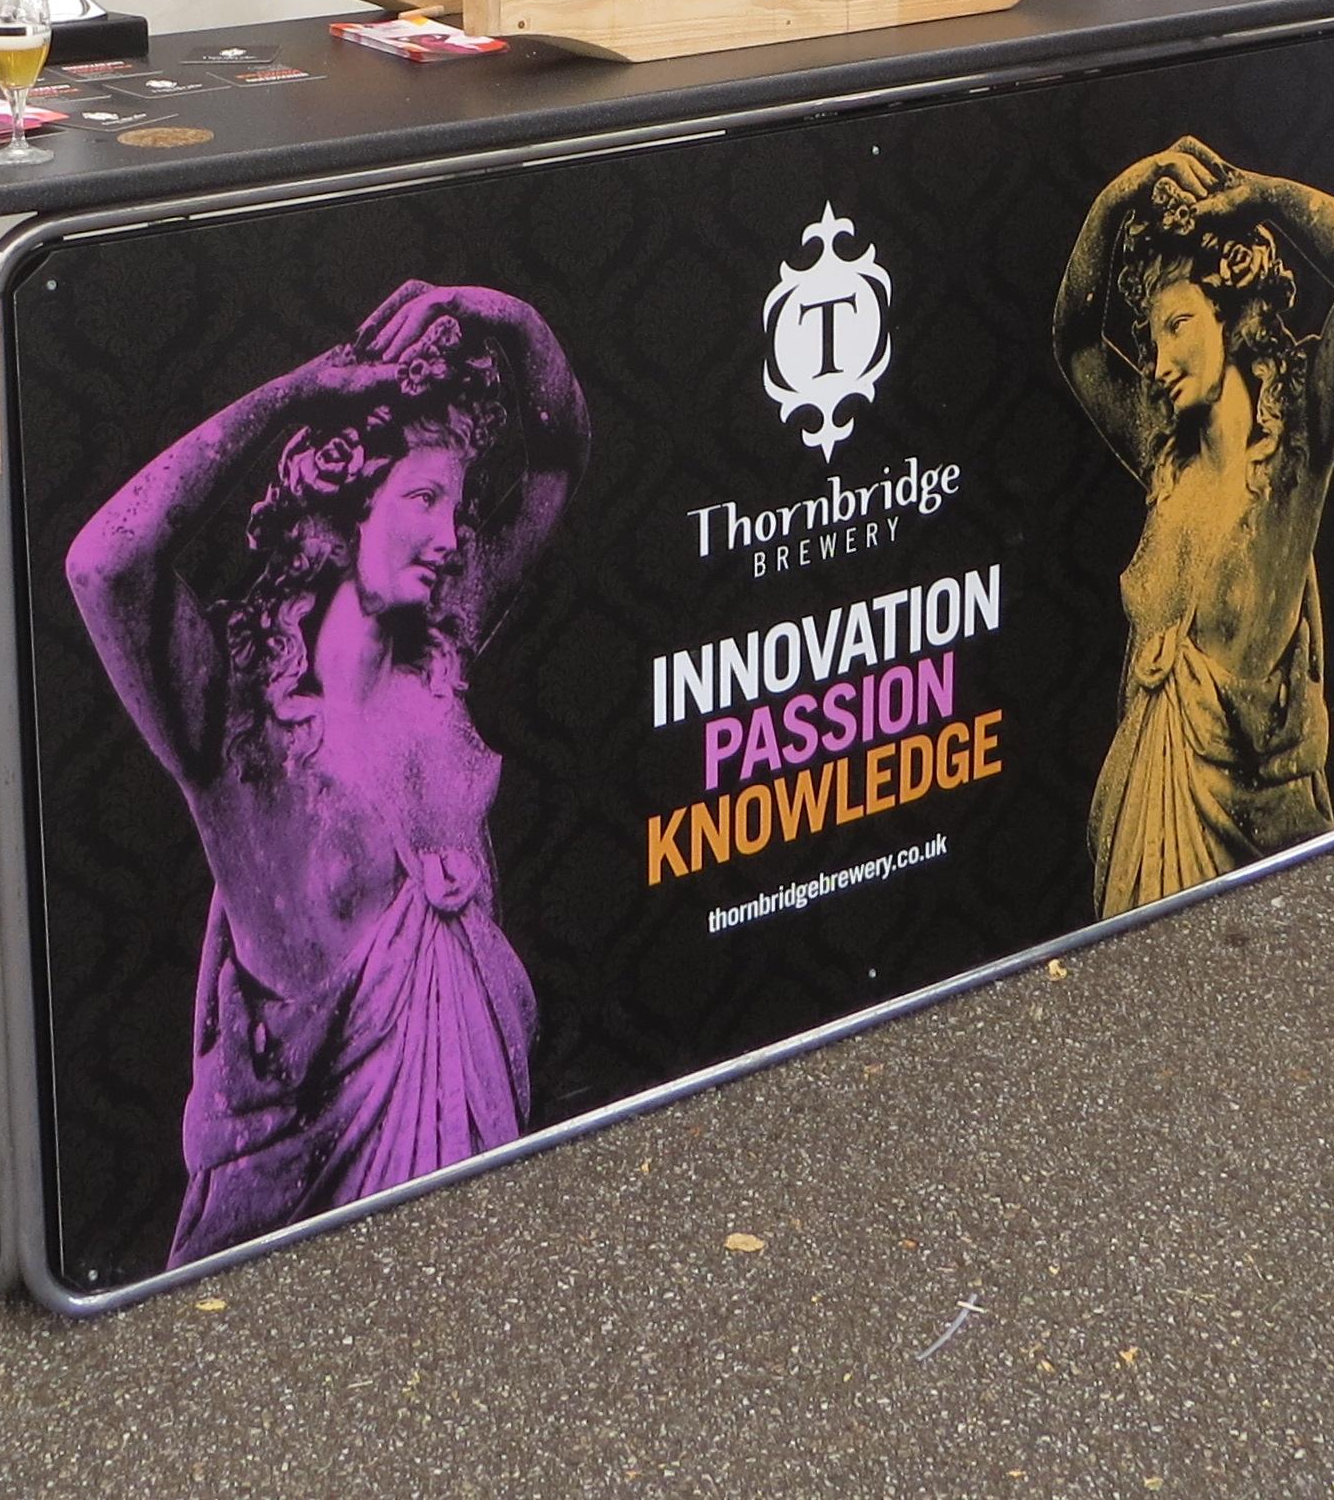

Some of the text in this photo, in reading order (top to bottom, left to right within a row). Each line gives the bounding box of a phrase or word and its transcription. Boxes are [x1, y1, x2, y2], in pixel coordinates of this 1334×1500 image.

[798, 293, 860, 380] T
[687, 457, 962, 558] Thornbridge
[753, 516, 901, 578] BREWERY
[652, 563, 1002, 728] INNOVATION
[704, 650, 955, 791] PASSION
[646, 708, 1004, 887] KNOWLEDGE
[708, 833, 948, 935] thornbridgebrewery.co.uk
